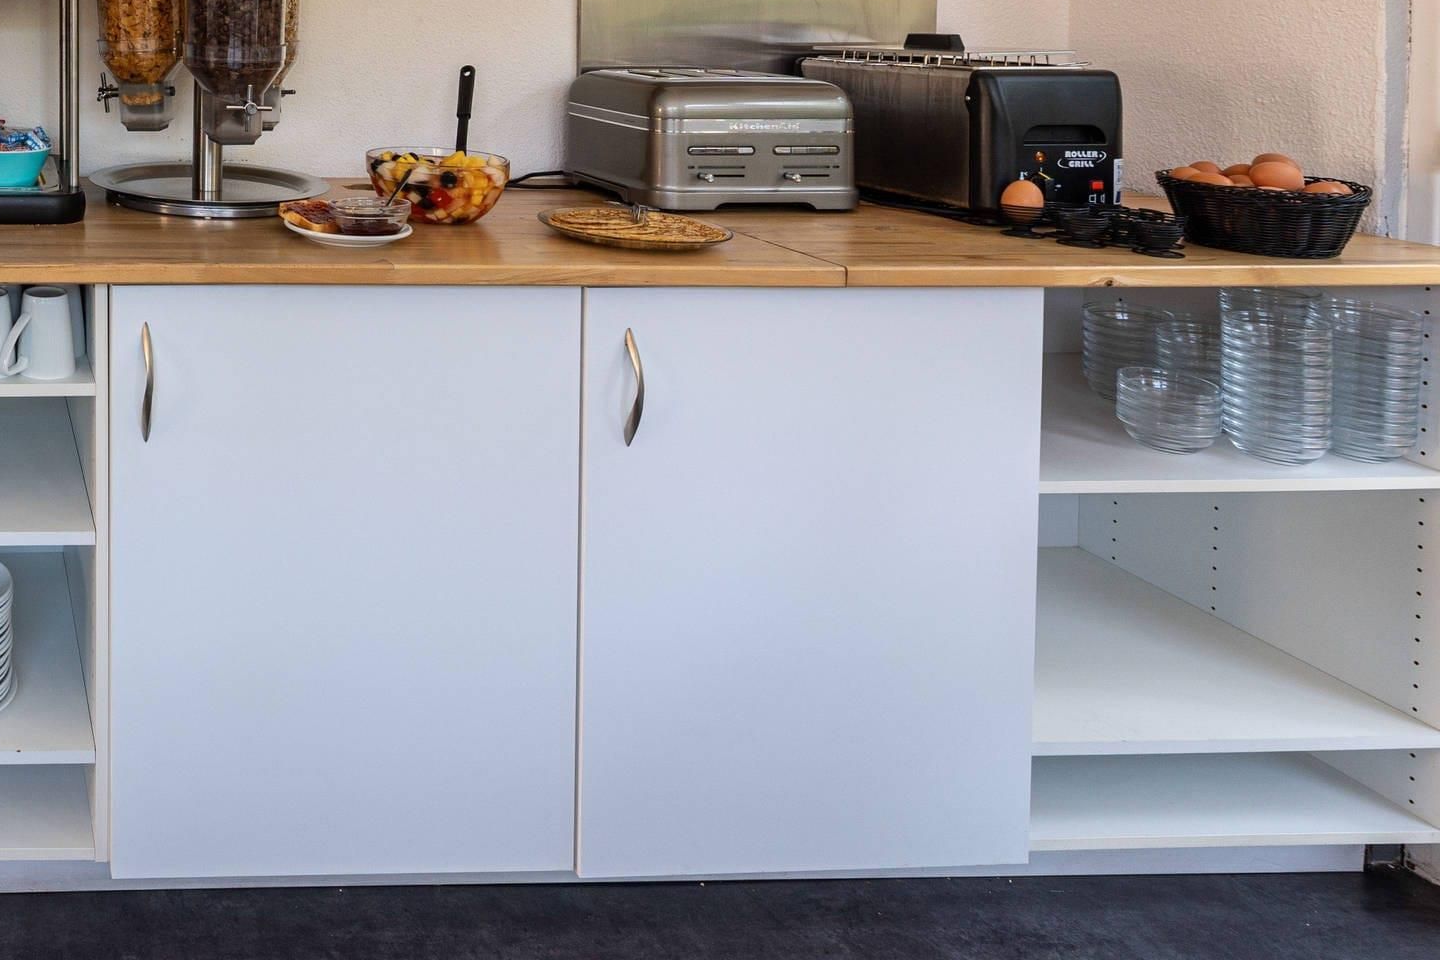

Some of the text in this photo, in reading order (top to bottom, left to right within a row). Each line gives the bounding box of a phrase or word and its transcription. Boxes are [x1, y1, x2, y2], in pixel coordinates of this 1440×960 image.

[728, 122, 801, 130] KitchenAid
[1064, 150, 1099, 159] ROLLER
[1068, 160, 1095, 168] GRILL
